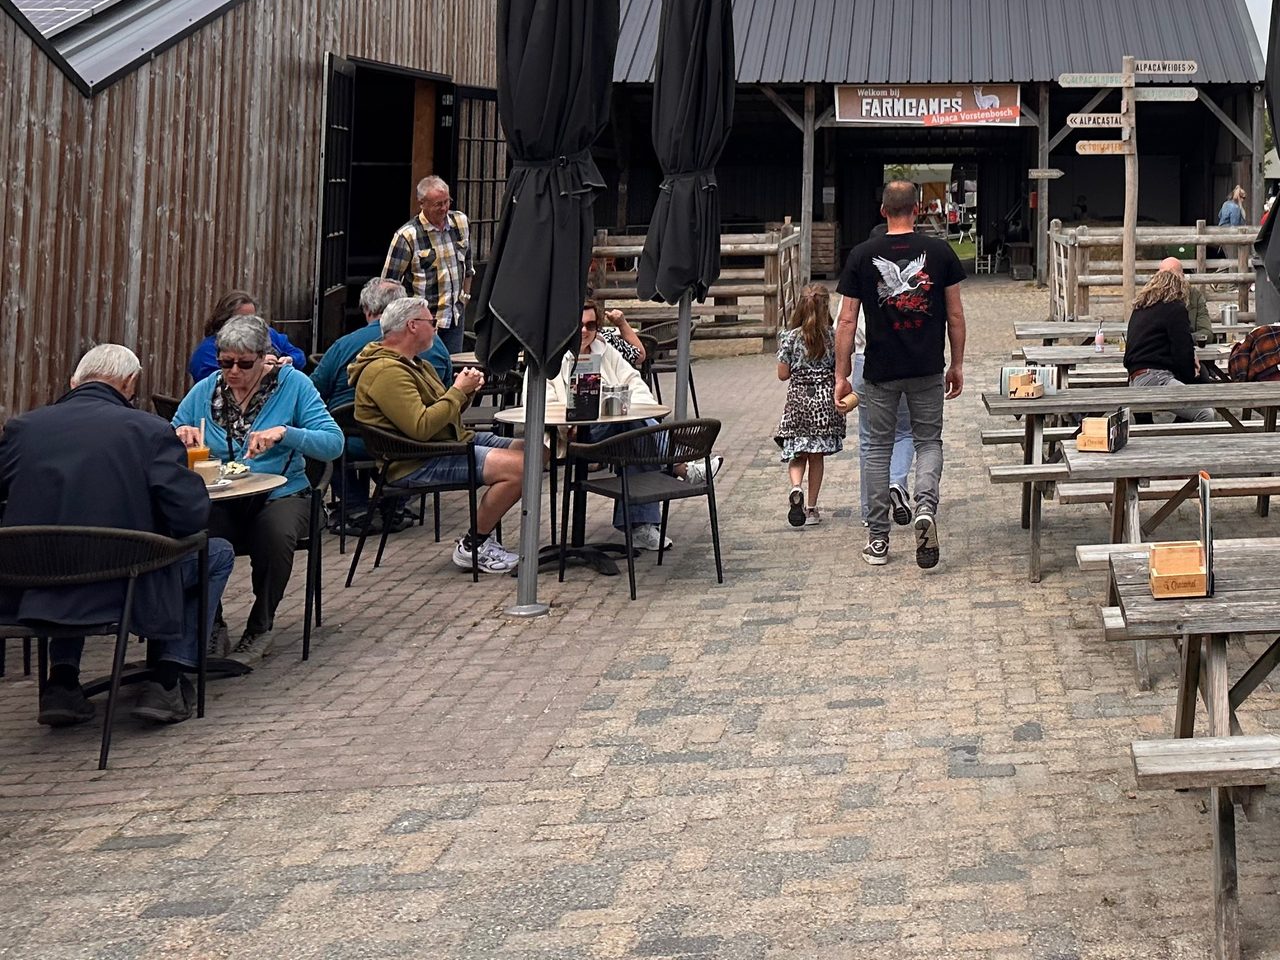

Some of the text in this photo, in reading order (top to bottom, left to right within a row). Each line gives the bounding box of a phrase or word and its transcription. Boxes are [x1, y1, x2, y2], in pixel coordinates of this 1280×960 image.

[1135, 63, 1186, 72] ALPACAWEIDES
[857, 88, 900, 98] Welkom bij
[861, 97, 963, 118] FARMCAMPS
[931, 109, 1013, 125] Alpaca Vorstenbosch
